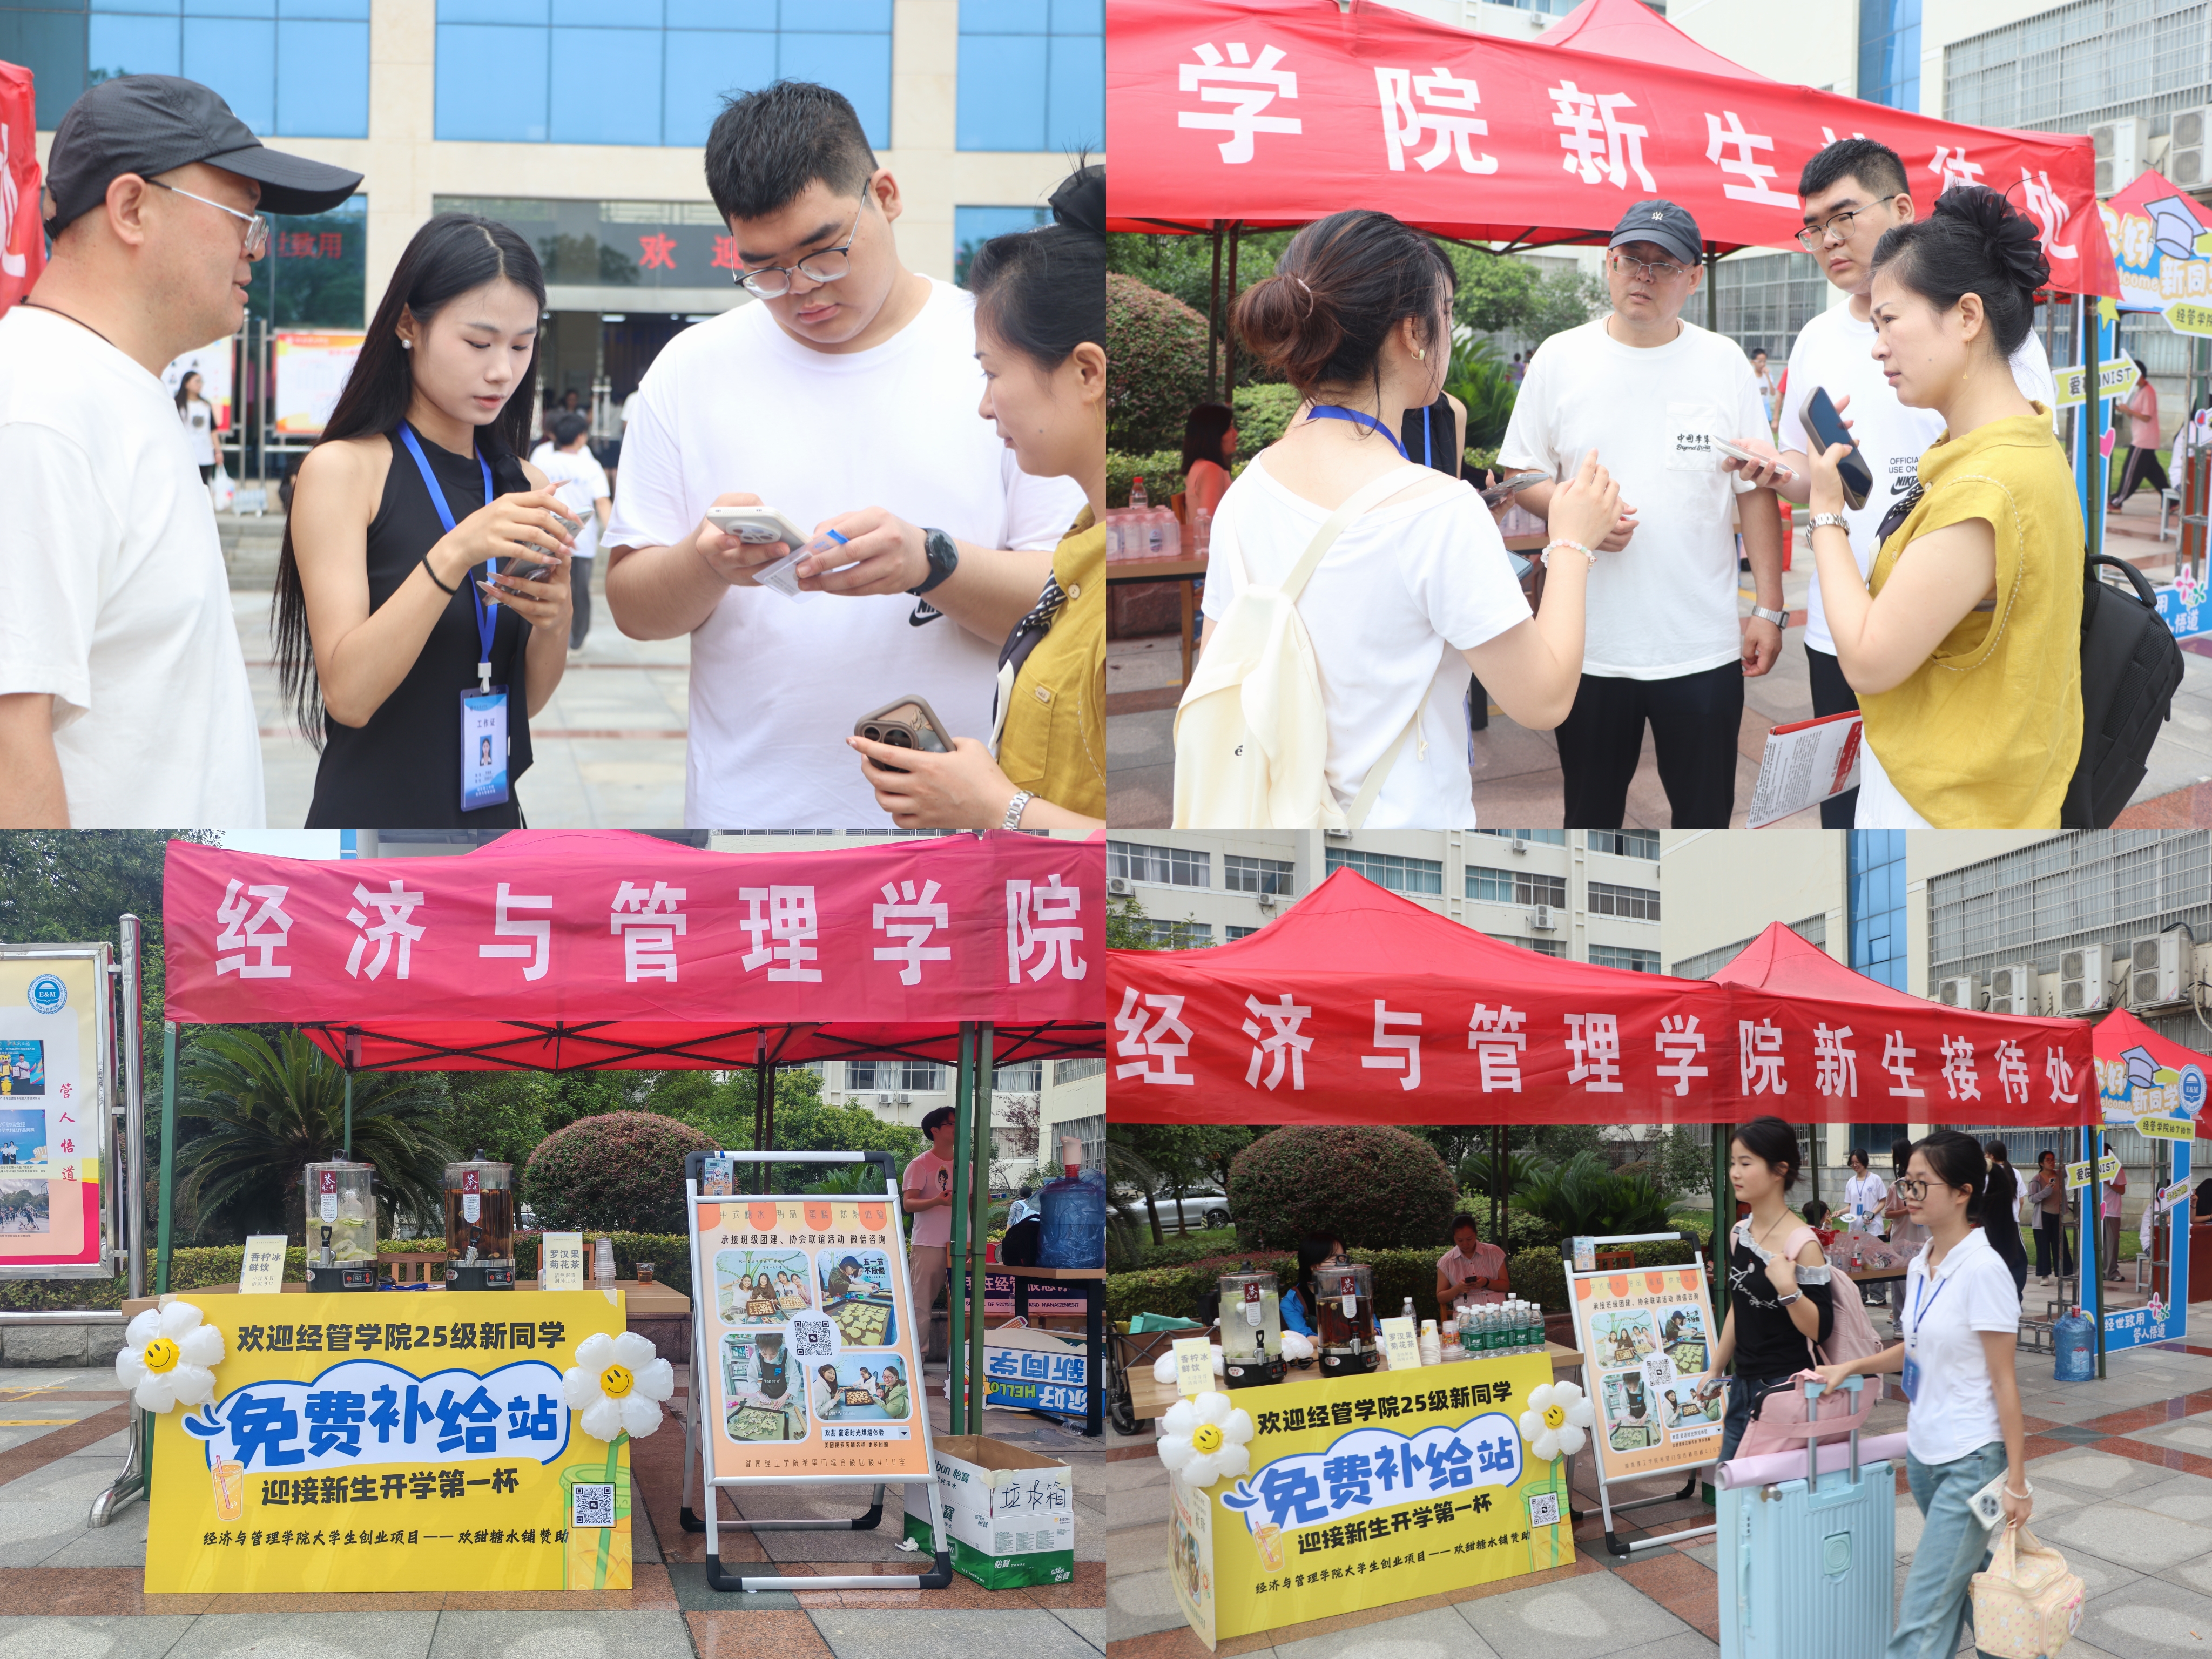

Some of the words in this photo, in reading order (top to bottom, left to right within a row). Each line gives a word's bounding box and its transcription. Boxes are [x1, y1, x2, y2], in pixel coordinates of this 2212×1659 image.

[1177, 42, 2079, 260] 学院新生待处
[2162, 257, 2212, 296] 新同
[1890, 457, 1921, 465] OFFICIA
[215, 873, 1086, 986] 经济与管理学院
[1114, 986, 2079, 1104] 经济与管理学院新生接待处
[2100, 1096, 2131, 1109] elcome
[2132, 1084, 2179, 1112] 新同学
[59, 1082, 77, 1182] 管人悟道
[2142, 1120, 2191, 1135] 经管学院拍了拍你
[720, 1210, 765, 1219] 中式糖水
[777, 1210, 797, 1219] 甜品
[809, 1210, 829, 1219] 蛋糕
[840, 1210, 885, 1219] 烘焙体验
[721, 1235, 845, 1244] 承接班级团建、协会联谊活动
[850, 1235, 886, 1244] 微信咨询
[251, 1252, 281, 1262] 香柠冰
[550, 1250, 580, 1259] 罗汉果
[864, 1258, 883, 1266] 五一节
[249, 1263, 269, 1272] 鲜饮
[550, 1260, 580, 1269] 菊花茶
[864, 1267, 886, 1275] 不放假
[1593, 1295, 1674, 1310] 承接班级团建、协会联谊活动
[1676, 1293, 1699, 1302] 微信咨询
[2104, 1312, 2145, 1332] 经世致用
[237, 1321, 565, 1352] 欢迎经管学院25级新同学
[1388, 1331, 1413, 1340] 罗汉果
[2133, 1322, 2166, 1344] 管人悟道
[1391, 1340, 1415, 1350] 菊花茶
[1181, 1353, 1209, 1363] 香柠冰
[989, 1351, 1084, 1384] 新同学
[1182, 1364, 1201, 1373] 鲜饮
[990, 1380, 1036, 1398] HELLO
[1257, 1380, 1513, 1435] 欢迎经管学院25级新同学
[226, 1384, 558, 1467] 免费补给站
[262, 1467, 520, 1507] 迎接新生开学第一杯
[1259, 1435, 1515, 1529] 免费补给站
[1000, 1479, 1066, 1510] 垃圾箱
[1297, 1493, 1492, 1555] 迎接新生开学第一杯
